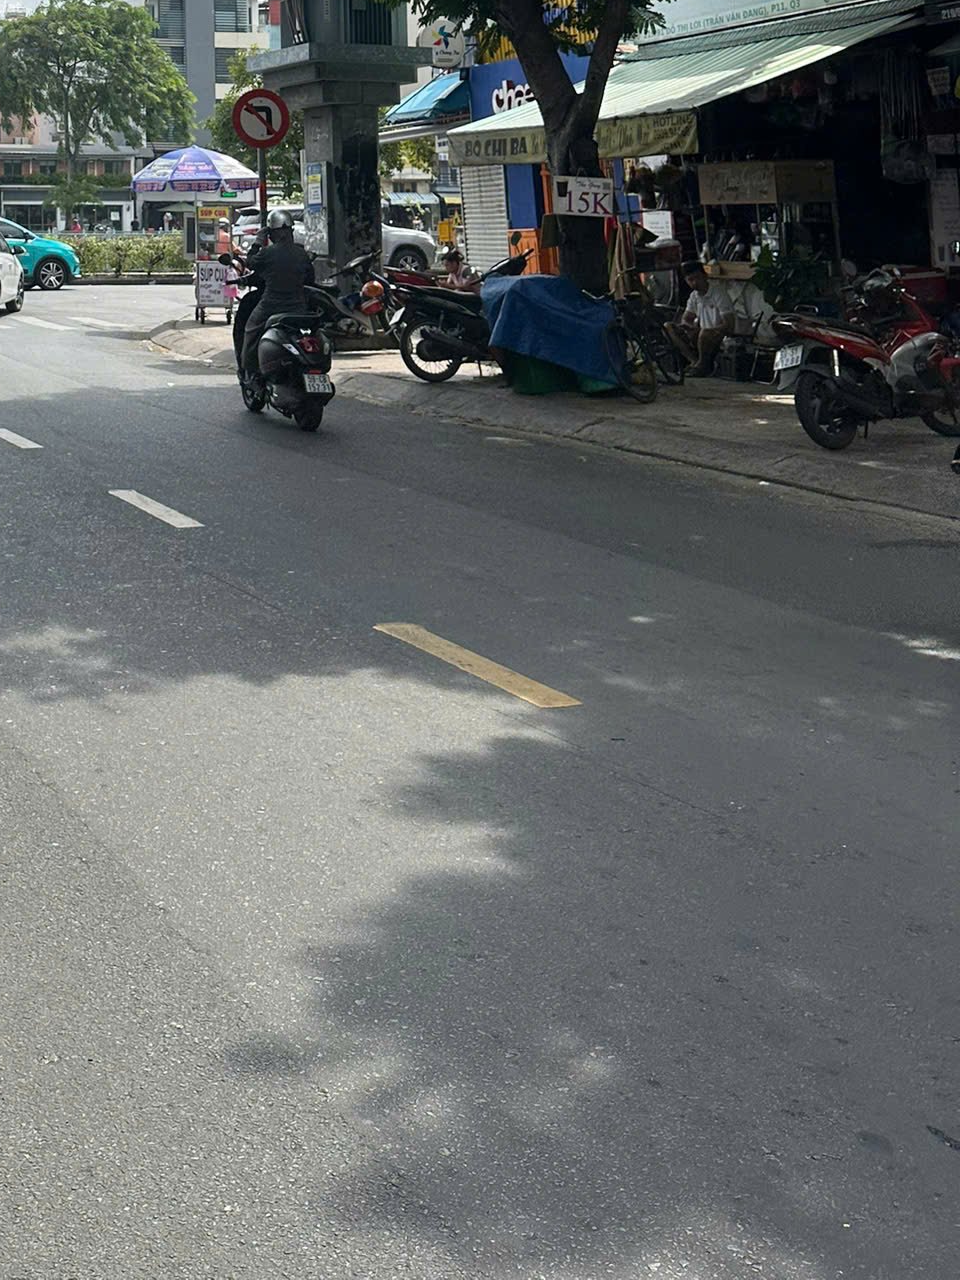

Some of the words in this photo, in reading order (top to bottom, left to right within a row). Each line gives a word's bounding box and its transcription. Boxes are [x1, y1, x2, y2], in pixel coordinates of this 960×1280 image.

[790, 0, 801, 10] Q3
[510, 137, 527, 155] BA
[566, 190, 611, 215] 15K
